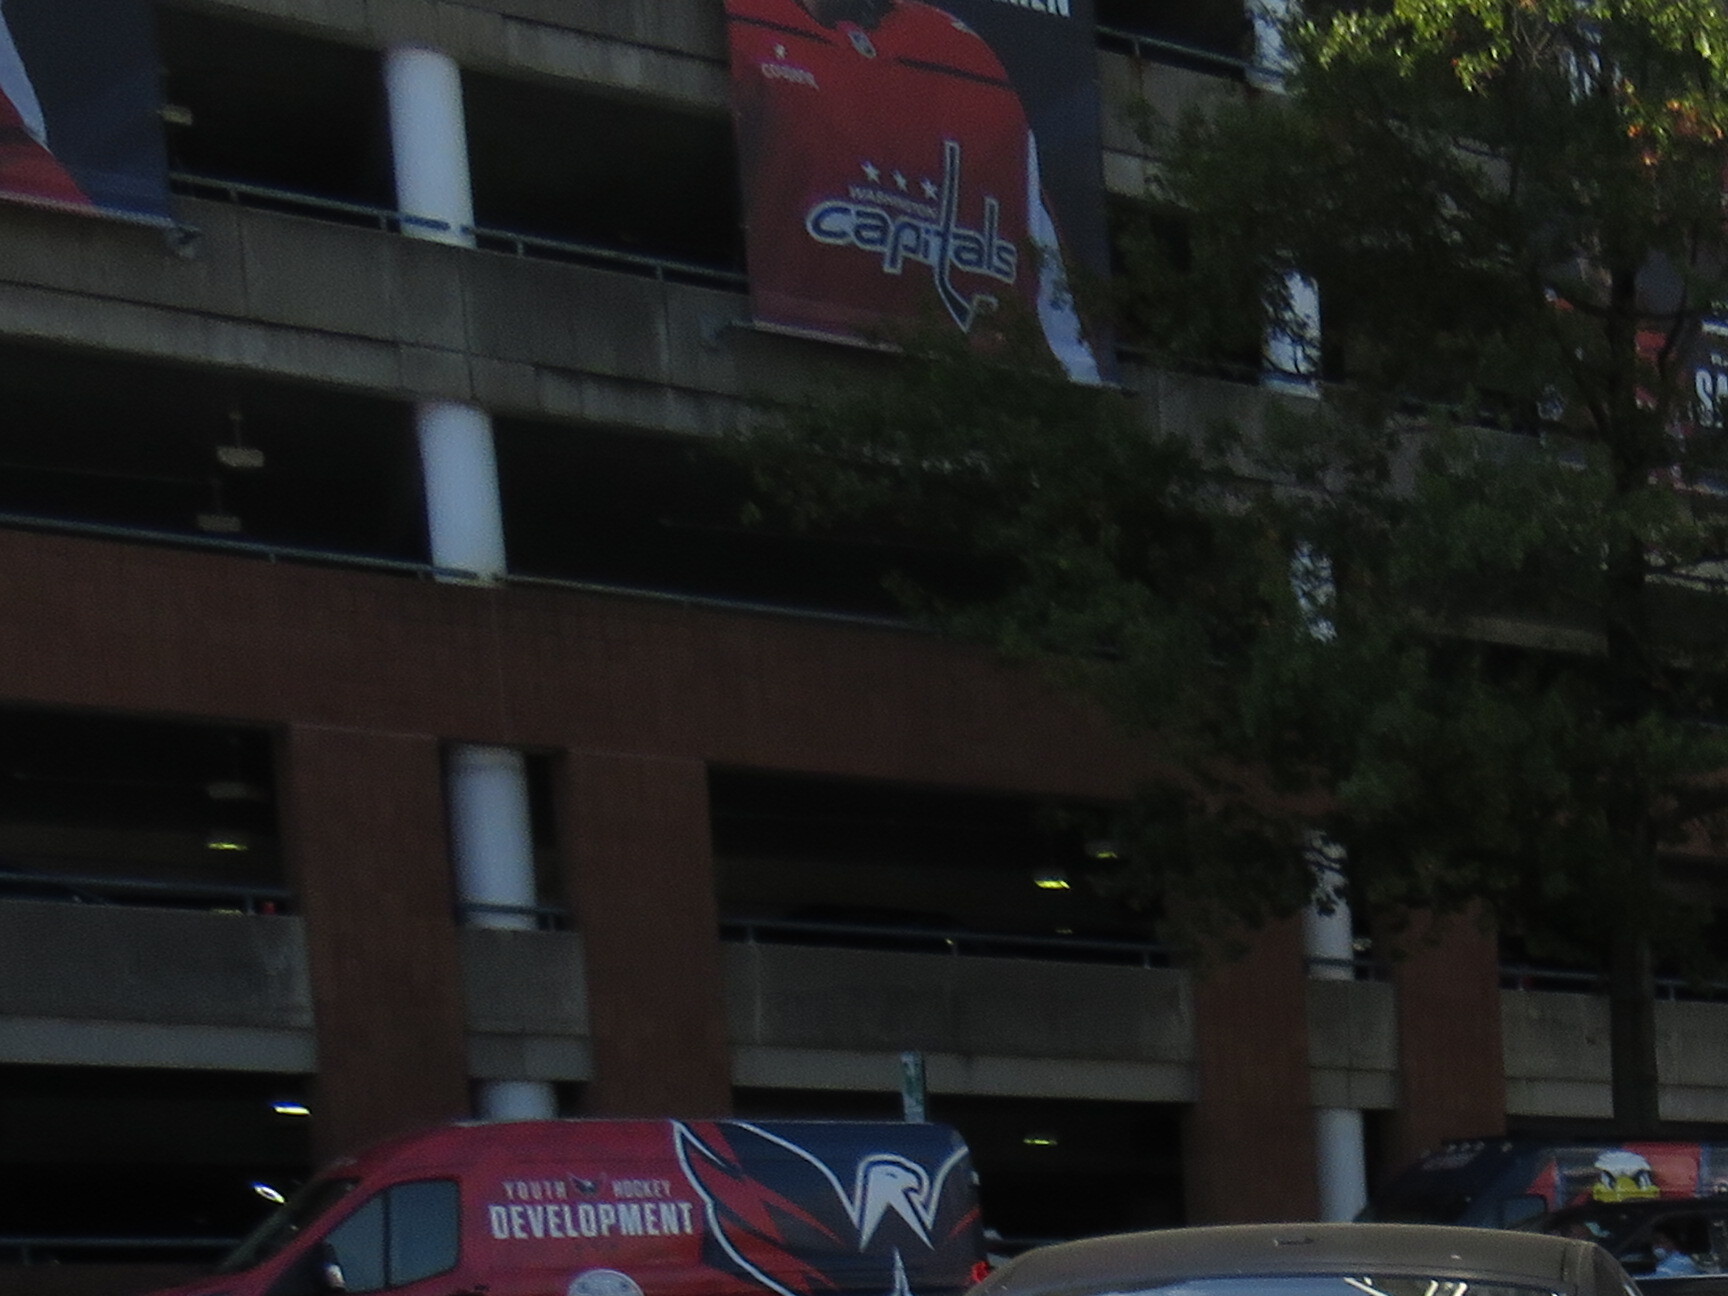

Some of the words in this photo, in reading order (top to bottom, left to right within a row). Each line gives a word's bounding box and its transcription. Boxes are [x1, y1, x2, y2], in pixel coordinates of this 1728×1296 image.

[806, 139, 1018, 332] capitals
[502, 1180, 568, 1200] YOUTH
[611, 1178, 672, 1199] HOCKEY
[487, 1201, 694, 1240] DEVELOPMENT
